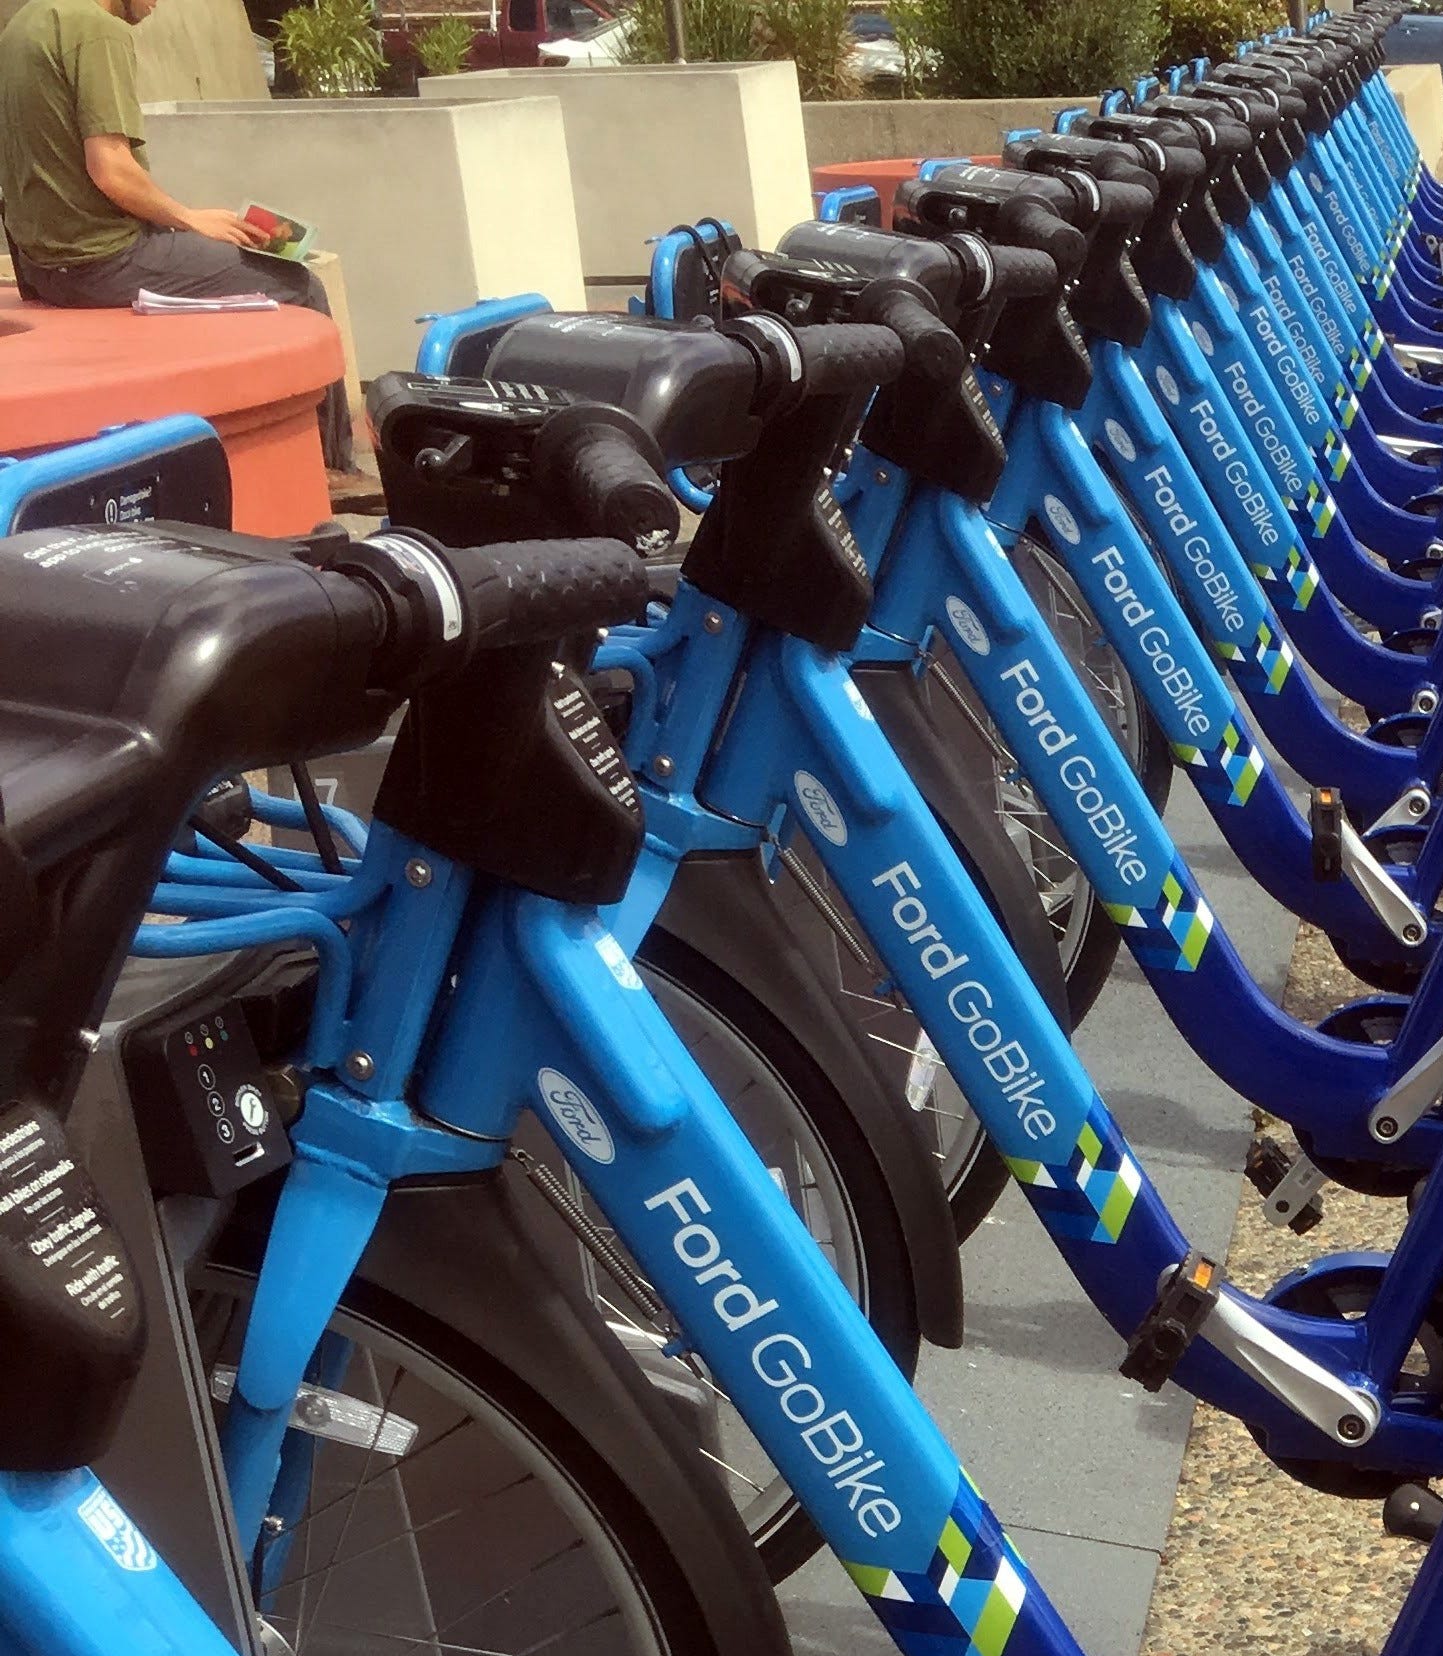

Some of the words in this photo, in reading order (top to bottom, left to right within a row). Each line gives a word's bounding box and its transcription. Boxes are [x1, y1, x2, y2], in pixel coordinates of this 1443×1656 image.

[1303, 221, 1331, 260] Ford
[1324, 260, 1357, 313] GoBike
[1324, 190, 1349, 224] Ford
[1342, 224, 1370, 272] GoBike
[1263, 275, 1296, 321] Ford
[1287, 321, 1326, 383] GoBike
[1288, 254, 1319, 297] Ford
[1310, 296, 1346, 354] GoBike
[1250, 305, 1287, 357] Ford
[1277, 355, 1320, 425] GoBike
[1189, 399, 1237, 462] Ford
[1224, 460, 1280, 547] GoBike
[1223, 360, 1266, 417] Ford
[1254, 416, 1303, 493] GoBike
[1144, 465, 1198, 537] Ford
[1183, 535, 1245, 633] GoBike
[1091, 545, 1155, 628] Ford
[1139, 627, 1211, 737] GoBike
[1000, 659, 1077, 757] Ford
[1060, 755, 1147, 886] GoBike
[871, 860, 971, 979] Ford
[947, 979, 1057, 1141] GoBike
[550, 1090, 601, 1145] Ford
[31, 1235, 55, 1256] Obey
[65, 1278, 87, 1297] Ride
[81, 1266, 102, 1287] with
[643, 1176, 779, 1332] Ford
[751, 1332, 902, 1538] GoBike
